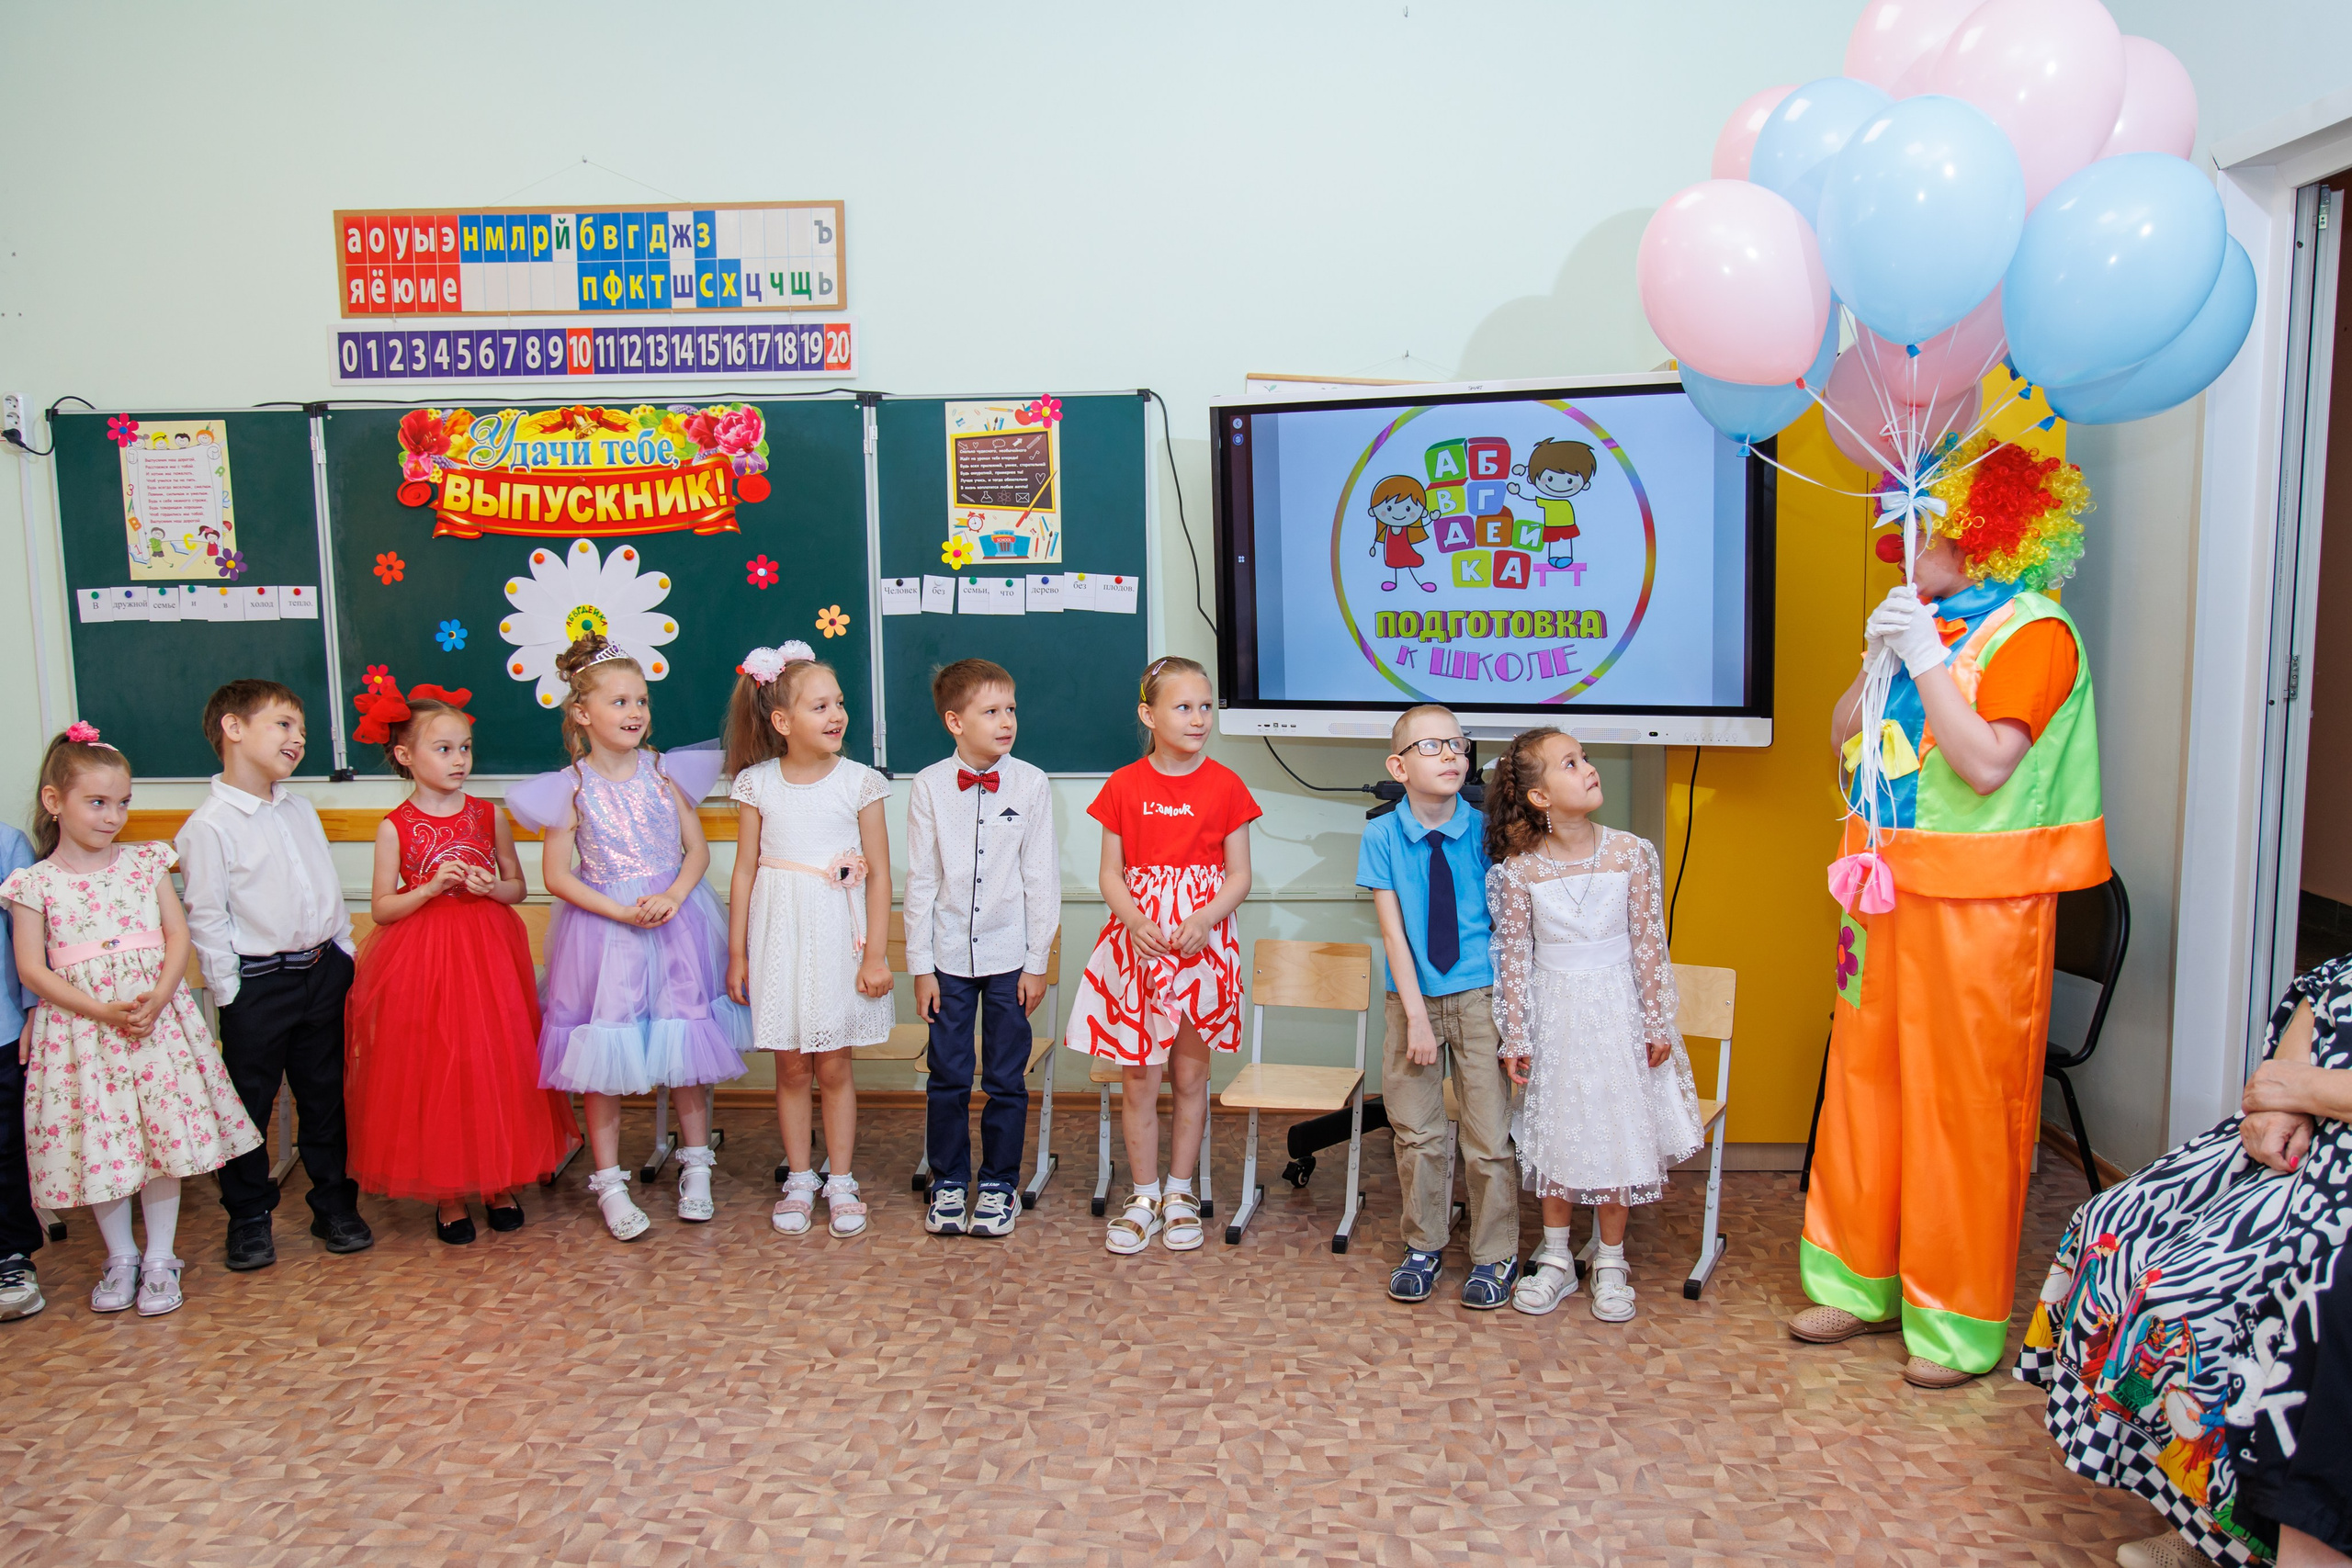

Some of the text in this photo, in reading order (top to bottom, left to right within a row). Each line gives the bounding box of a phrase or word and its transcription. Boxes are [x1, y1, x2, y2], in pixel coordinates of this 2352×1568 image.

[343, 331, 850, 372] 0 1 2 3 4 5 6 7 8 9 10 11 12 13 14 15 16 17 18 19 20
[469, 412, 681, 472] Удачи тебе,
[442, 468, 728, 524] ВЫПУСКНИК!
[93, 602, 99, 610] В
[112, 600, 148, 610] дружной
[883, 586, 918, 595] Человек
[932, 585, 945, 595] без
[963, 586, 990, 595] семьи,
[1031, 587, 1058, 595] дерево
[1072, 581, 1087, 590] без
[1102, 583, 1135, 592] плодов.
[1374, 609, 1608, 643] ПОДГОТОВКА
[1429, 643, 1583, 682] ШКОЛЕ
